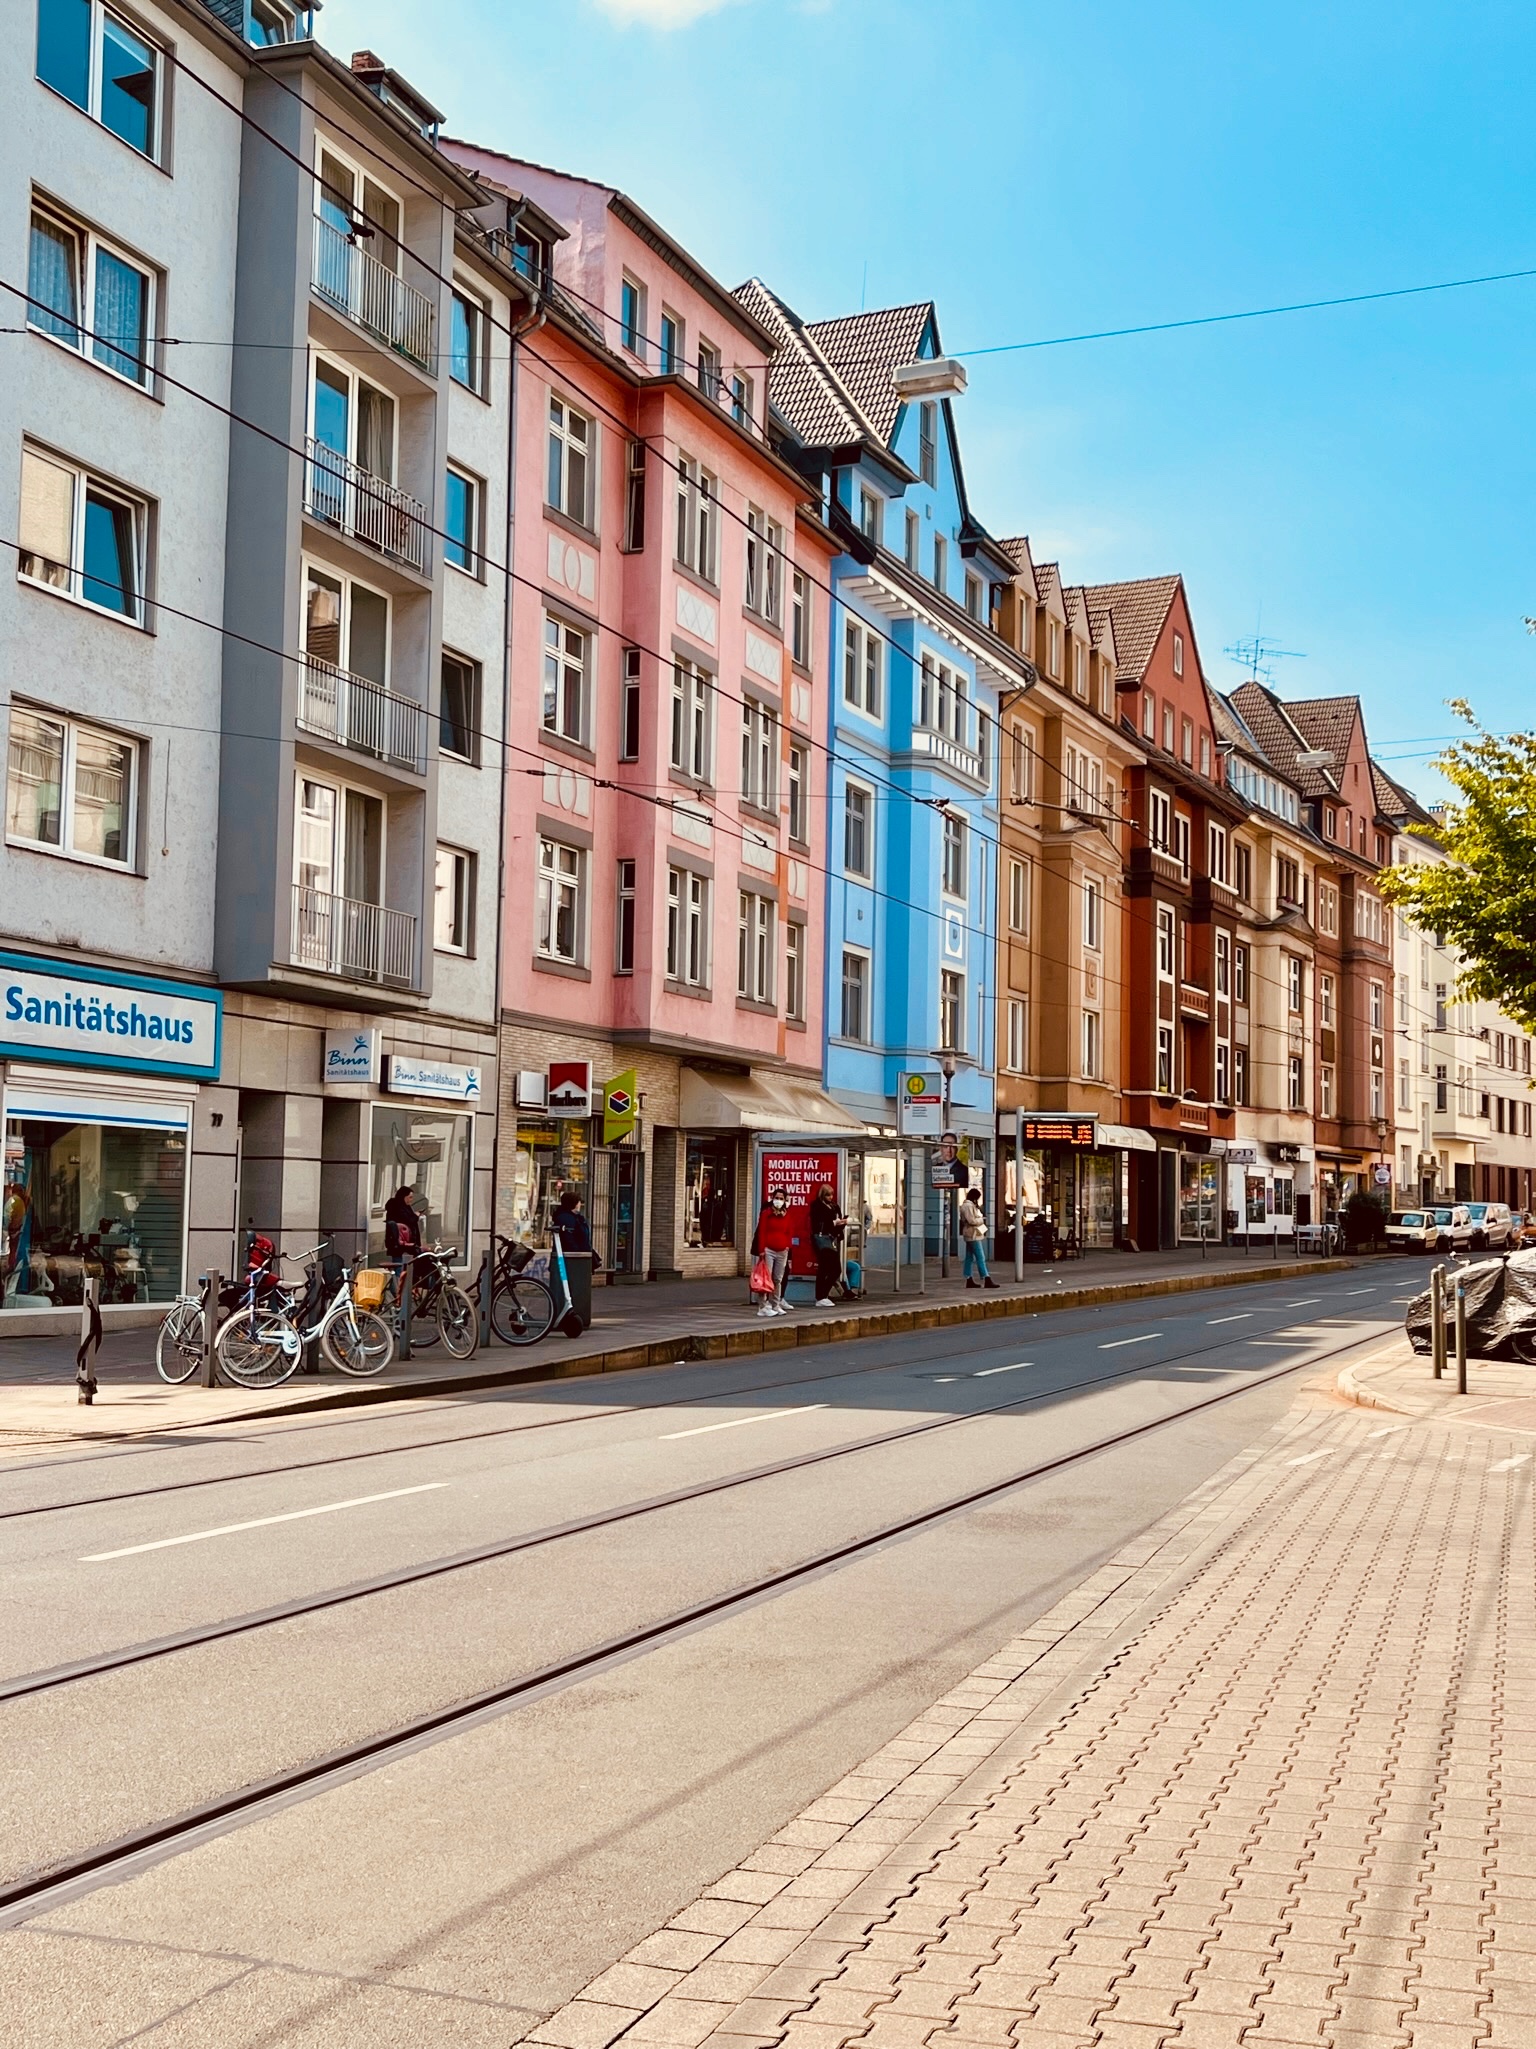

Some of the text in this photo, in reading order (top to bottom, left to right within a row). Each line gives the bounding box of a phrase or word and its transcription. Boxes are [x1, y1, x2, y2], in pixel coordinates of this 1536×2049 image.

[5, 986, 194, 1044] Sanitätshaus
[327, 1050, 369, 1066] Binn
[394, 1065, 461, 1087] Binn Sanitätshaus
[768, 1158, 819, 1169] MOBILITÄT
[768, 1172, 832, 1182] SOLLTE NICHT
[786, 1184, 811, 1193] WELT
